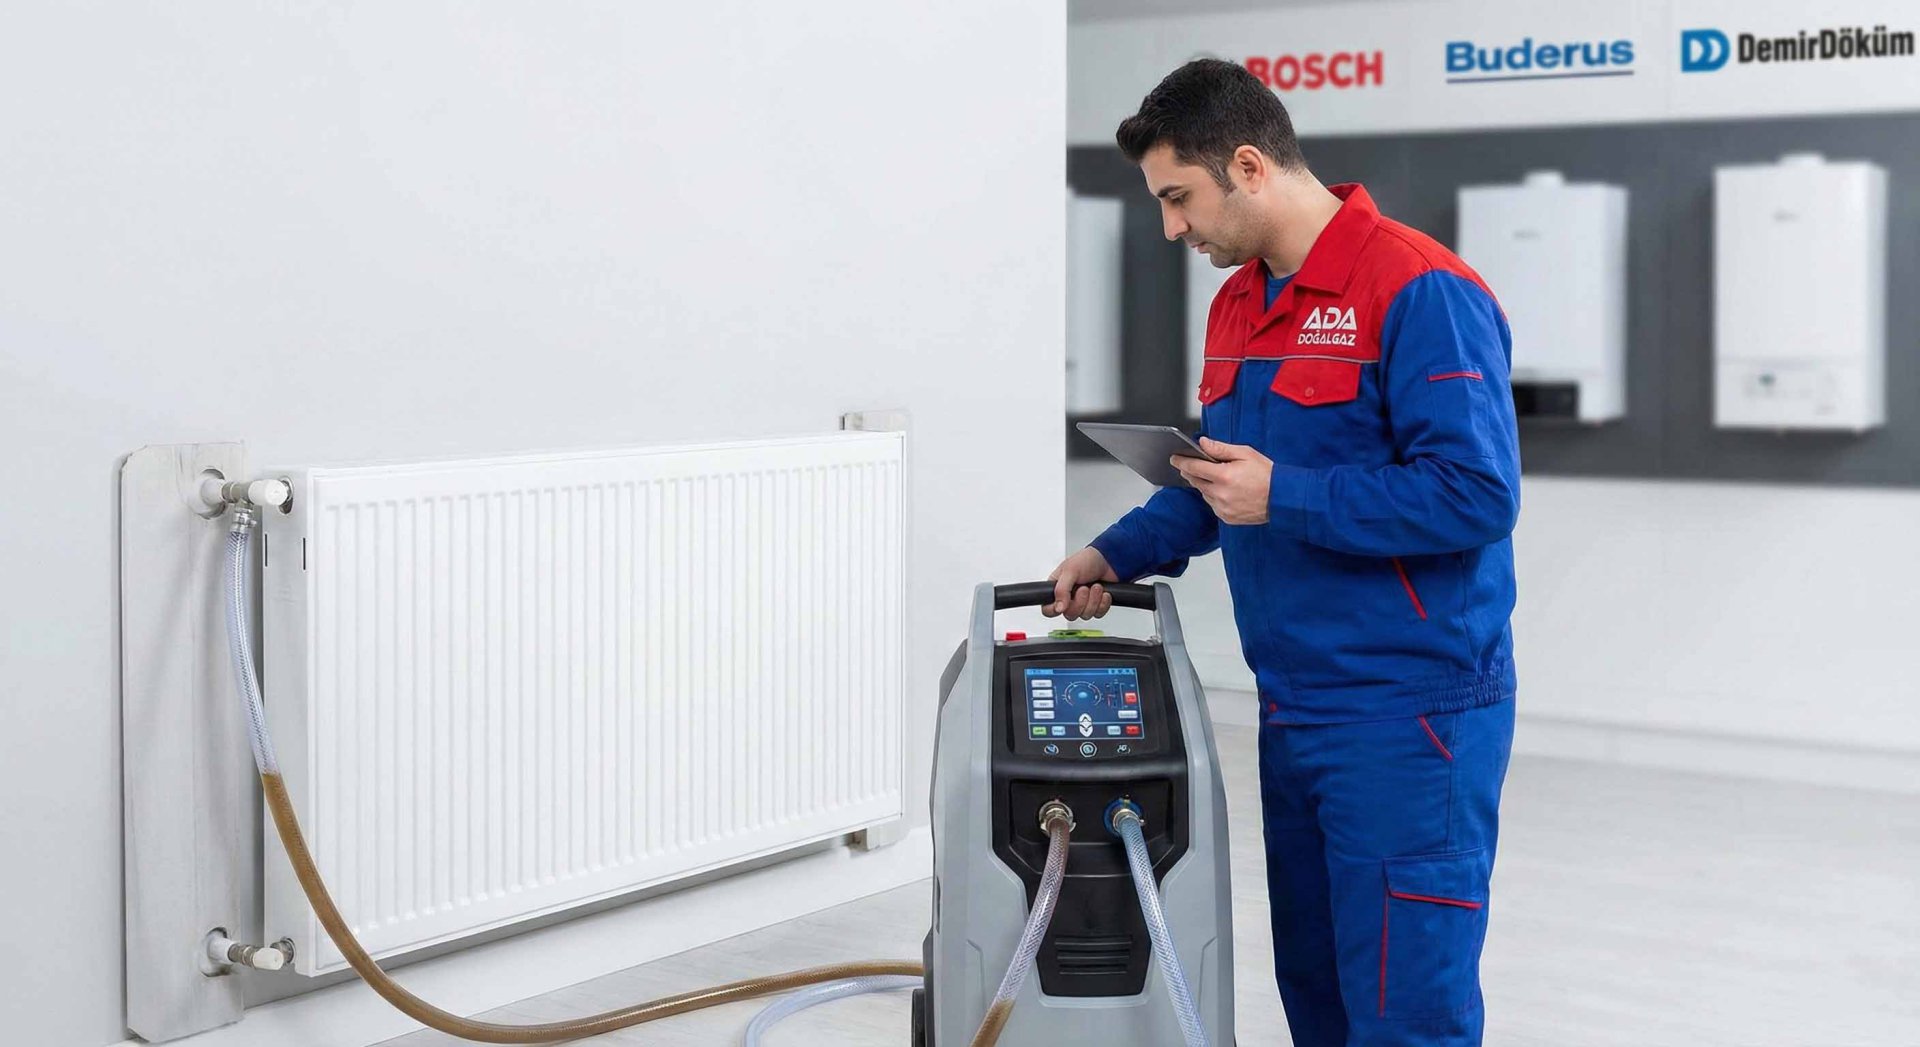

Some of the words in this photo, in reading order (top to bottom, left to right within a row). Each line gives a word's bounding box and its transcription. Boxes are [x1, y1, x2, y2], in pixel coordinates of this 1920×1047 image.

[1445, 37, 1635, 73] Buderus
[1737, 25, 1915, 64] DemirDöküm
[1301, 306, 1358, 330] ADA
[1297, 330, 1357, 347] DOĞALGAZ
